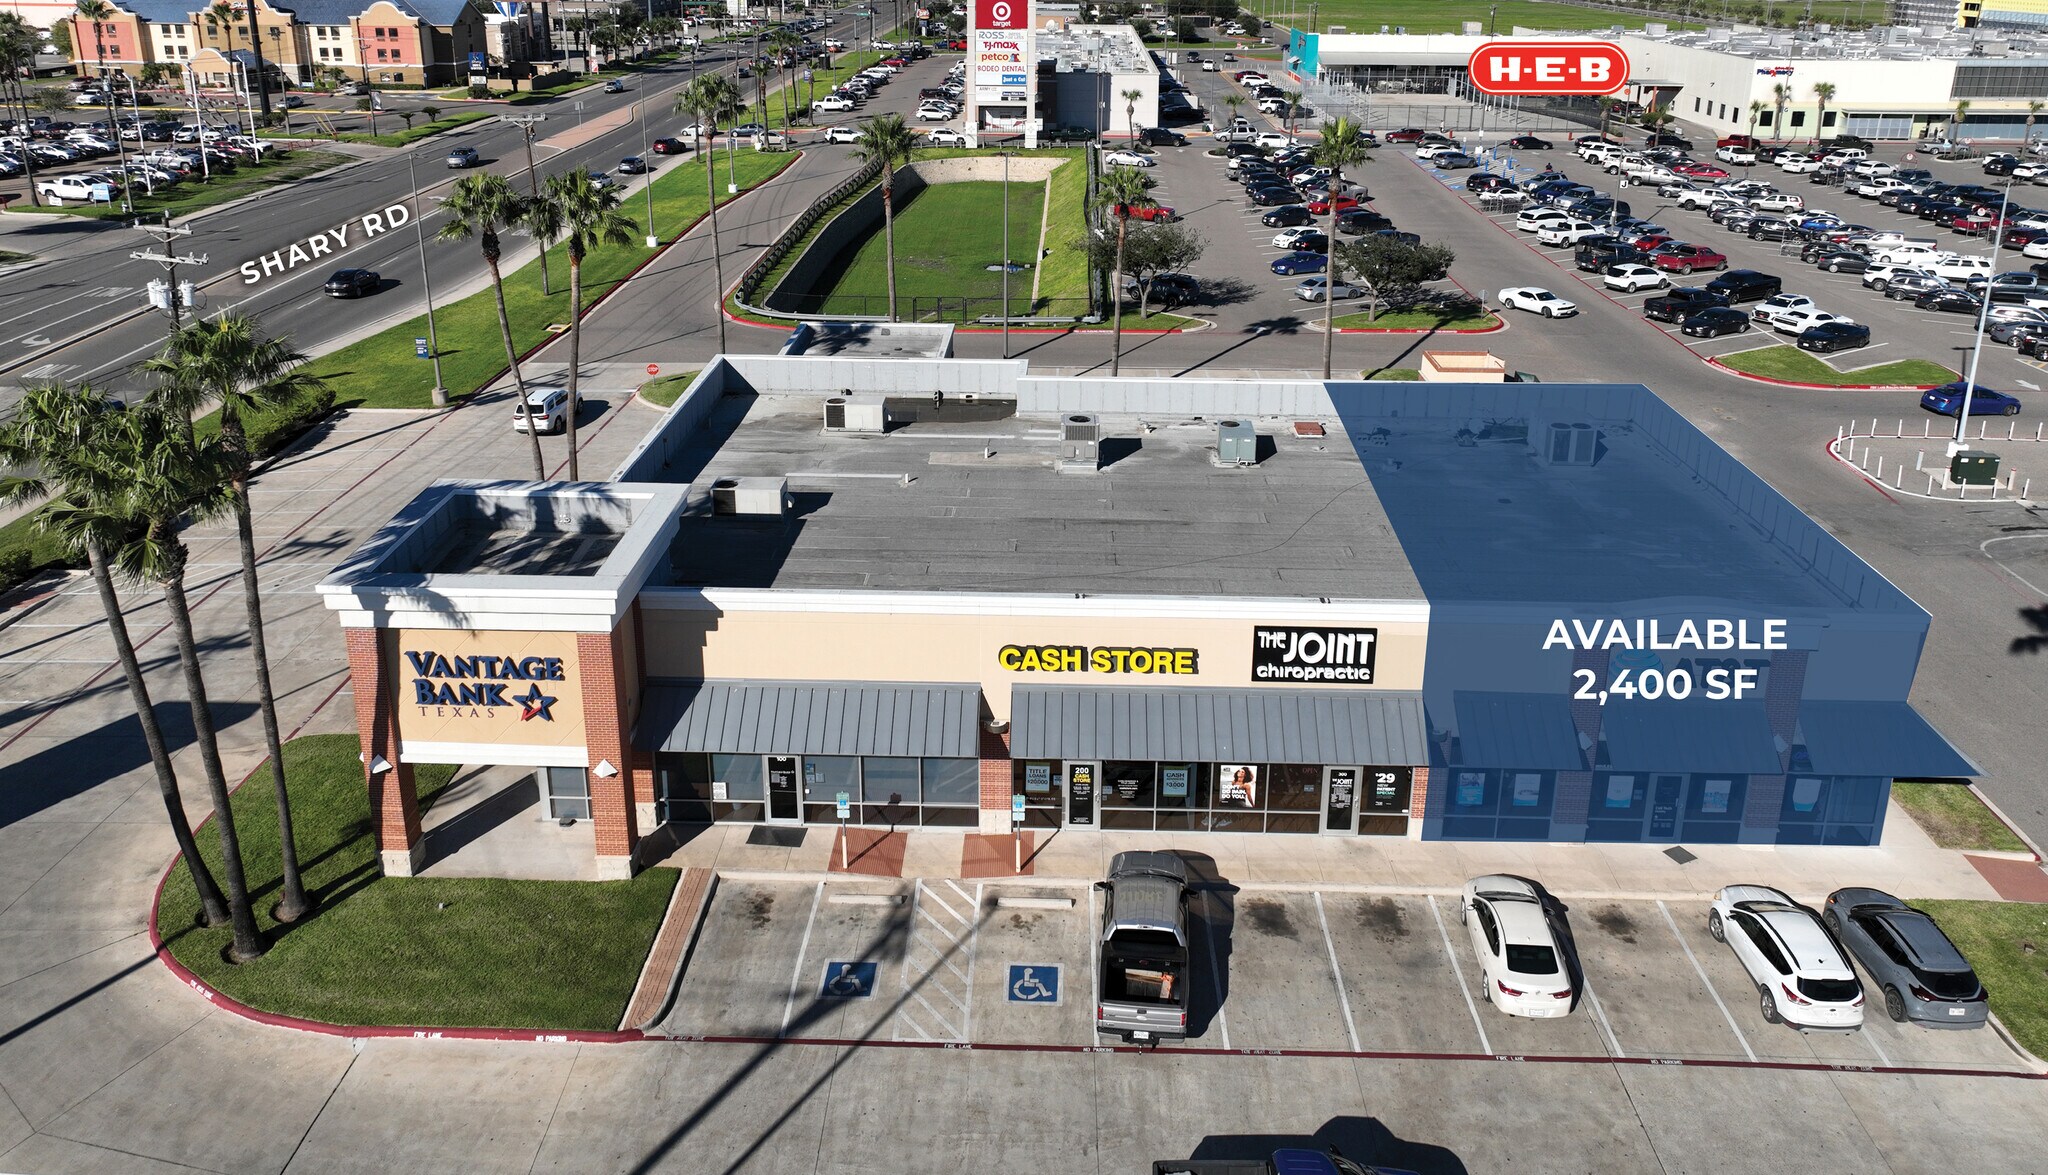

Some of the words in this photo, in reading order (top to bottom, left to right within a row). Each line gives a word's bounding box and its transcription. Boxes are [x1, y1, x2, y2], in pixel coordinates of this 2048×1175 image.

[979, 31, 1004, 39] ROSS
[981, 53, 1009, 62] petco
[1257, 630, 1287, 649] THE
[1283, 631, 1375, 665] JOINT
[404, 650, 565, 681] VANTAGE
[999, 645, 1086, 672] CASH
[1091, 647, 1197, 674] STORE
[1256, 662, 1371, 681] chiropractic
[412, 678, 514, 707] BANK
[418, 706, 495, 718] TEXAS
[1375, 772, 1396, 784] $29
[535, 1034, 544, 1042] NO
